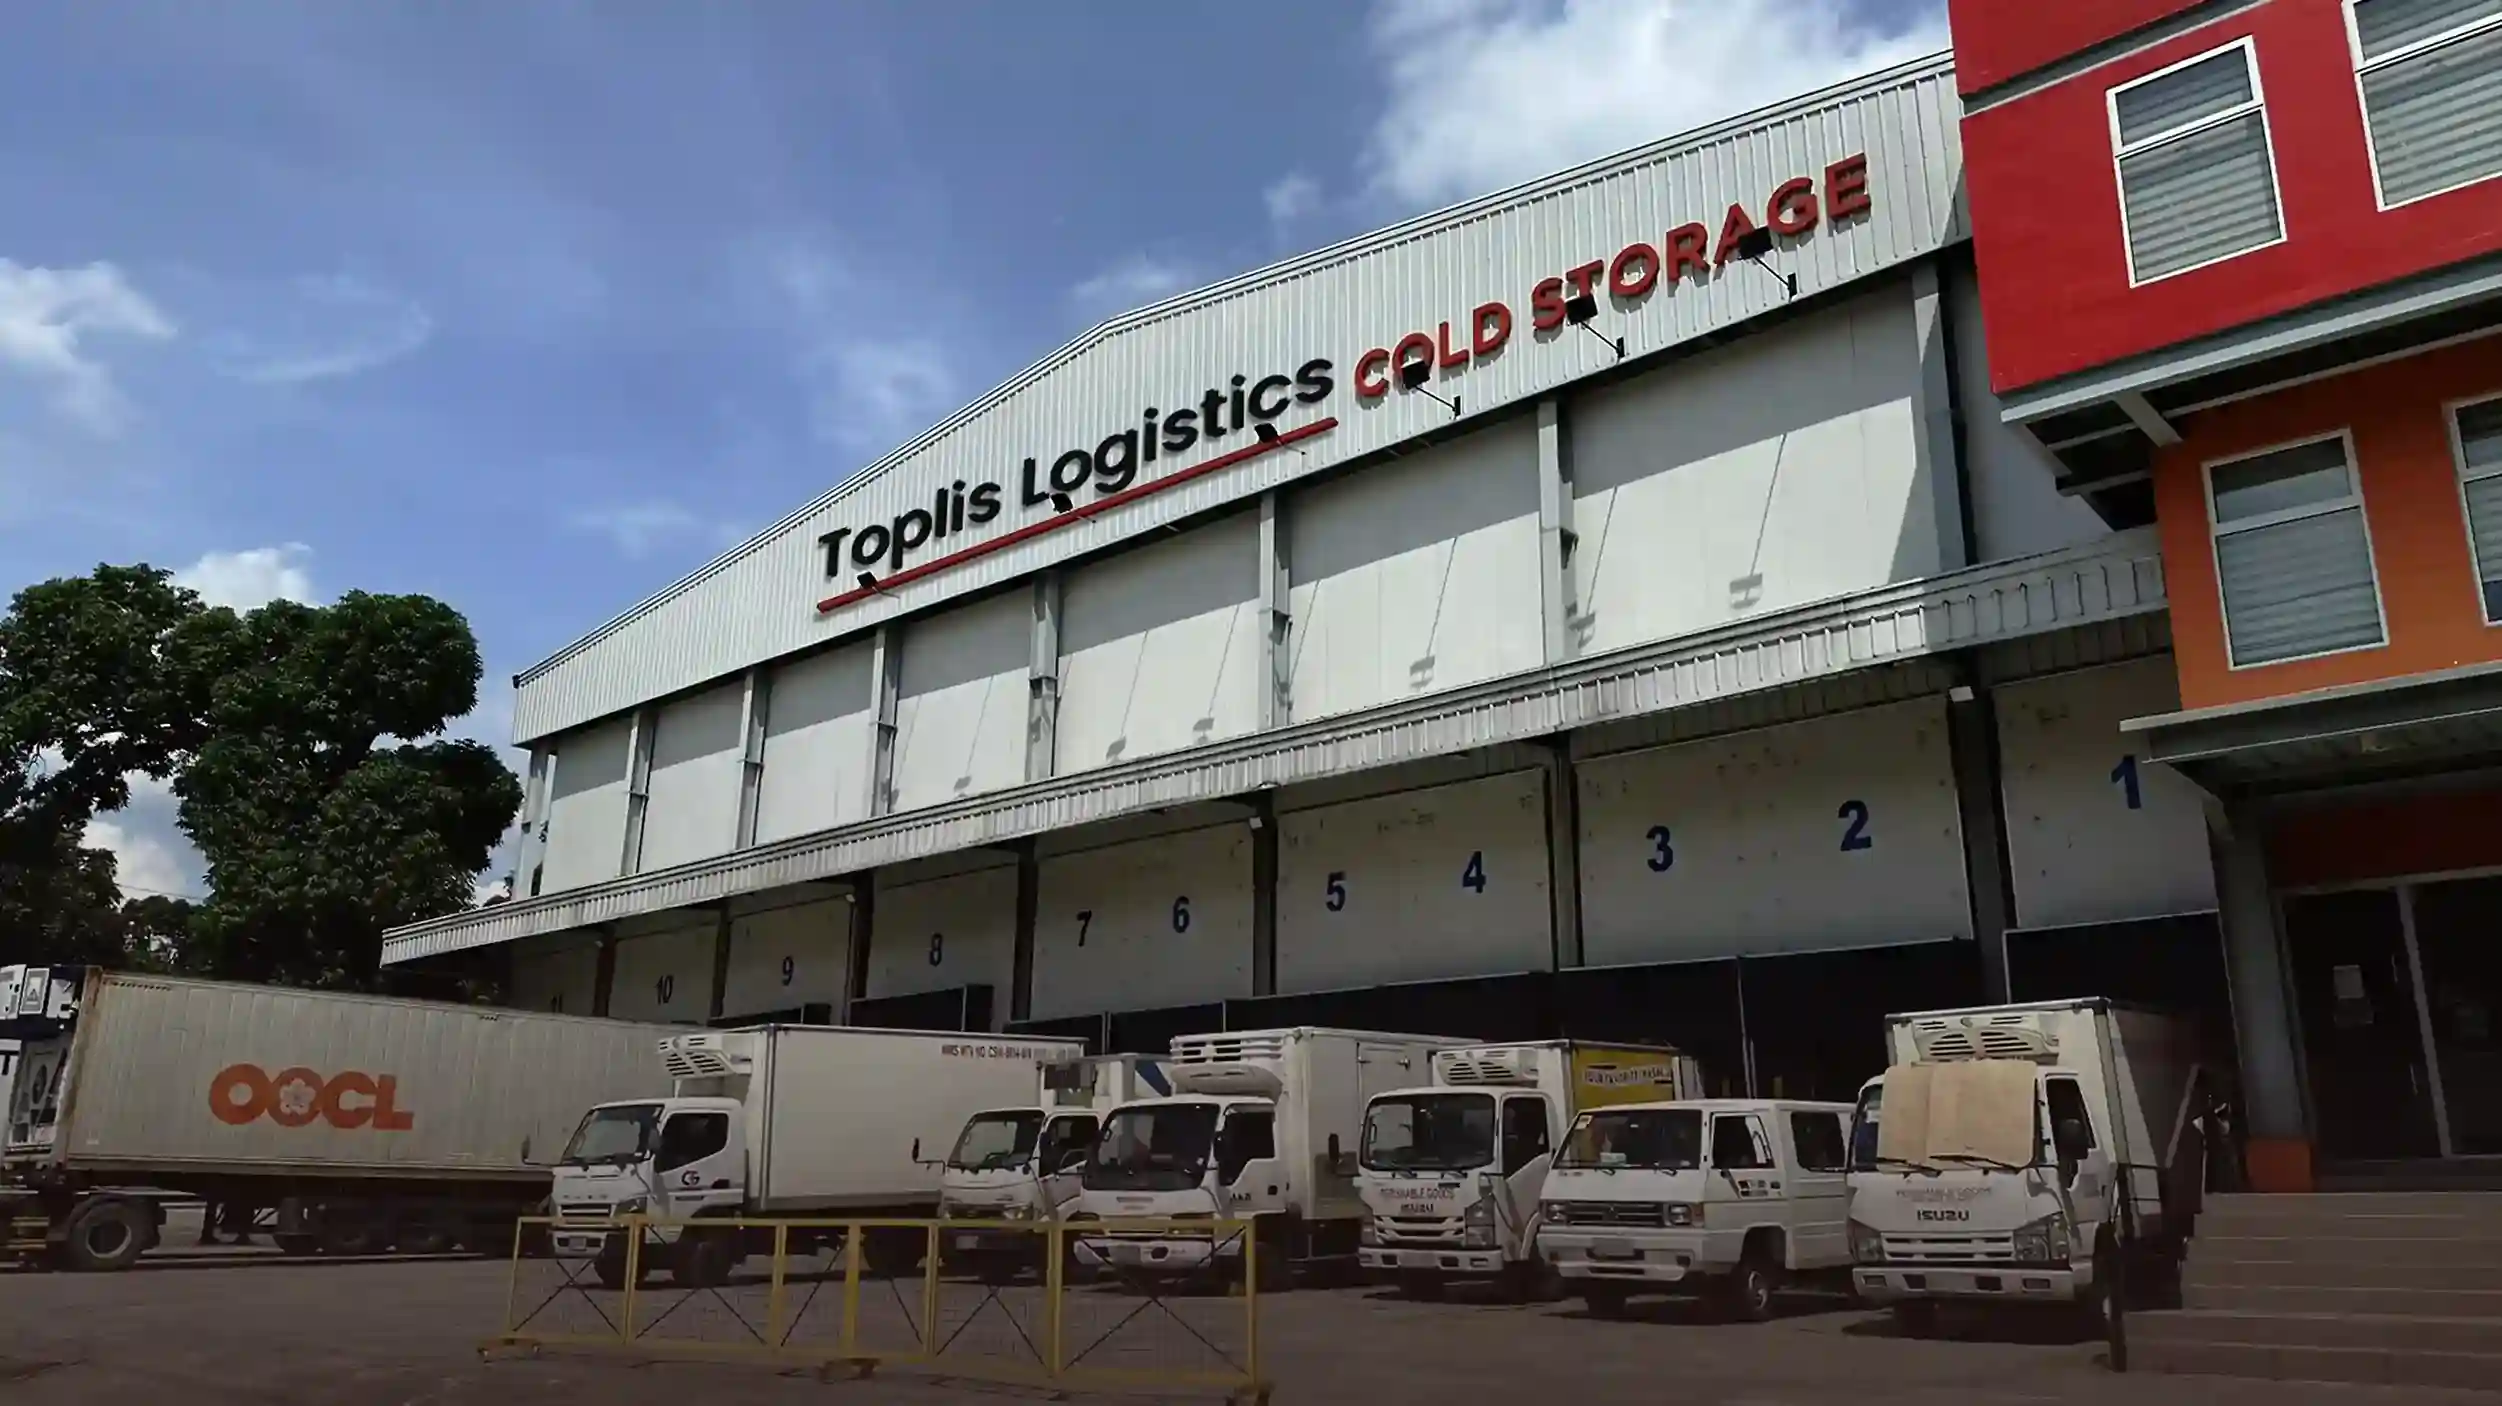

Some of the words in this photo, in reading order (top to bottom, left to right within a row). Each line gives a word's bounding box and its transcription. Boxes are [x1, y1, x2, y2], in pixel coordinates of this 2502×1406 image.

[1354, 302, 1512, 398] COLD
[1532, 152, 1872, 330] STORAGE
[818, 479, 1001, 577] Toplis
[1022, 358, 1334, 507] Logistics
[2110, 755, 2141, 810] 1
[1839, 800, 1872, 851] 2
[1646, 826, 1673, 872] 3
[1325, 871, 1347, 912] 5
[1462, 851, 1486, 893] 4
[1076, 910, 1091, 947] 7
[1171, 896, 1190, 934] 6
[929, 933, 943, 967] 8
[655, 975, 673, 1004] 10
[781, 956, 794, 987] 9
[208, 1064, 413, 1130] OOCL
[1916, 1209, 1970, 1221] ISUZU
